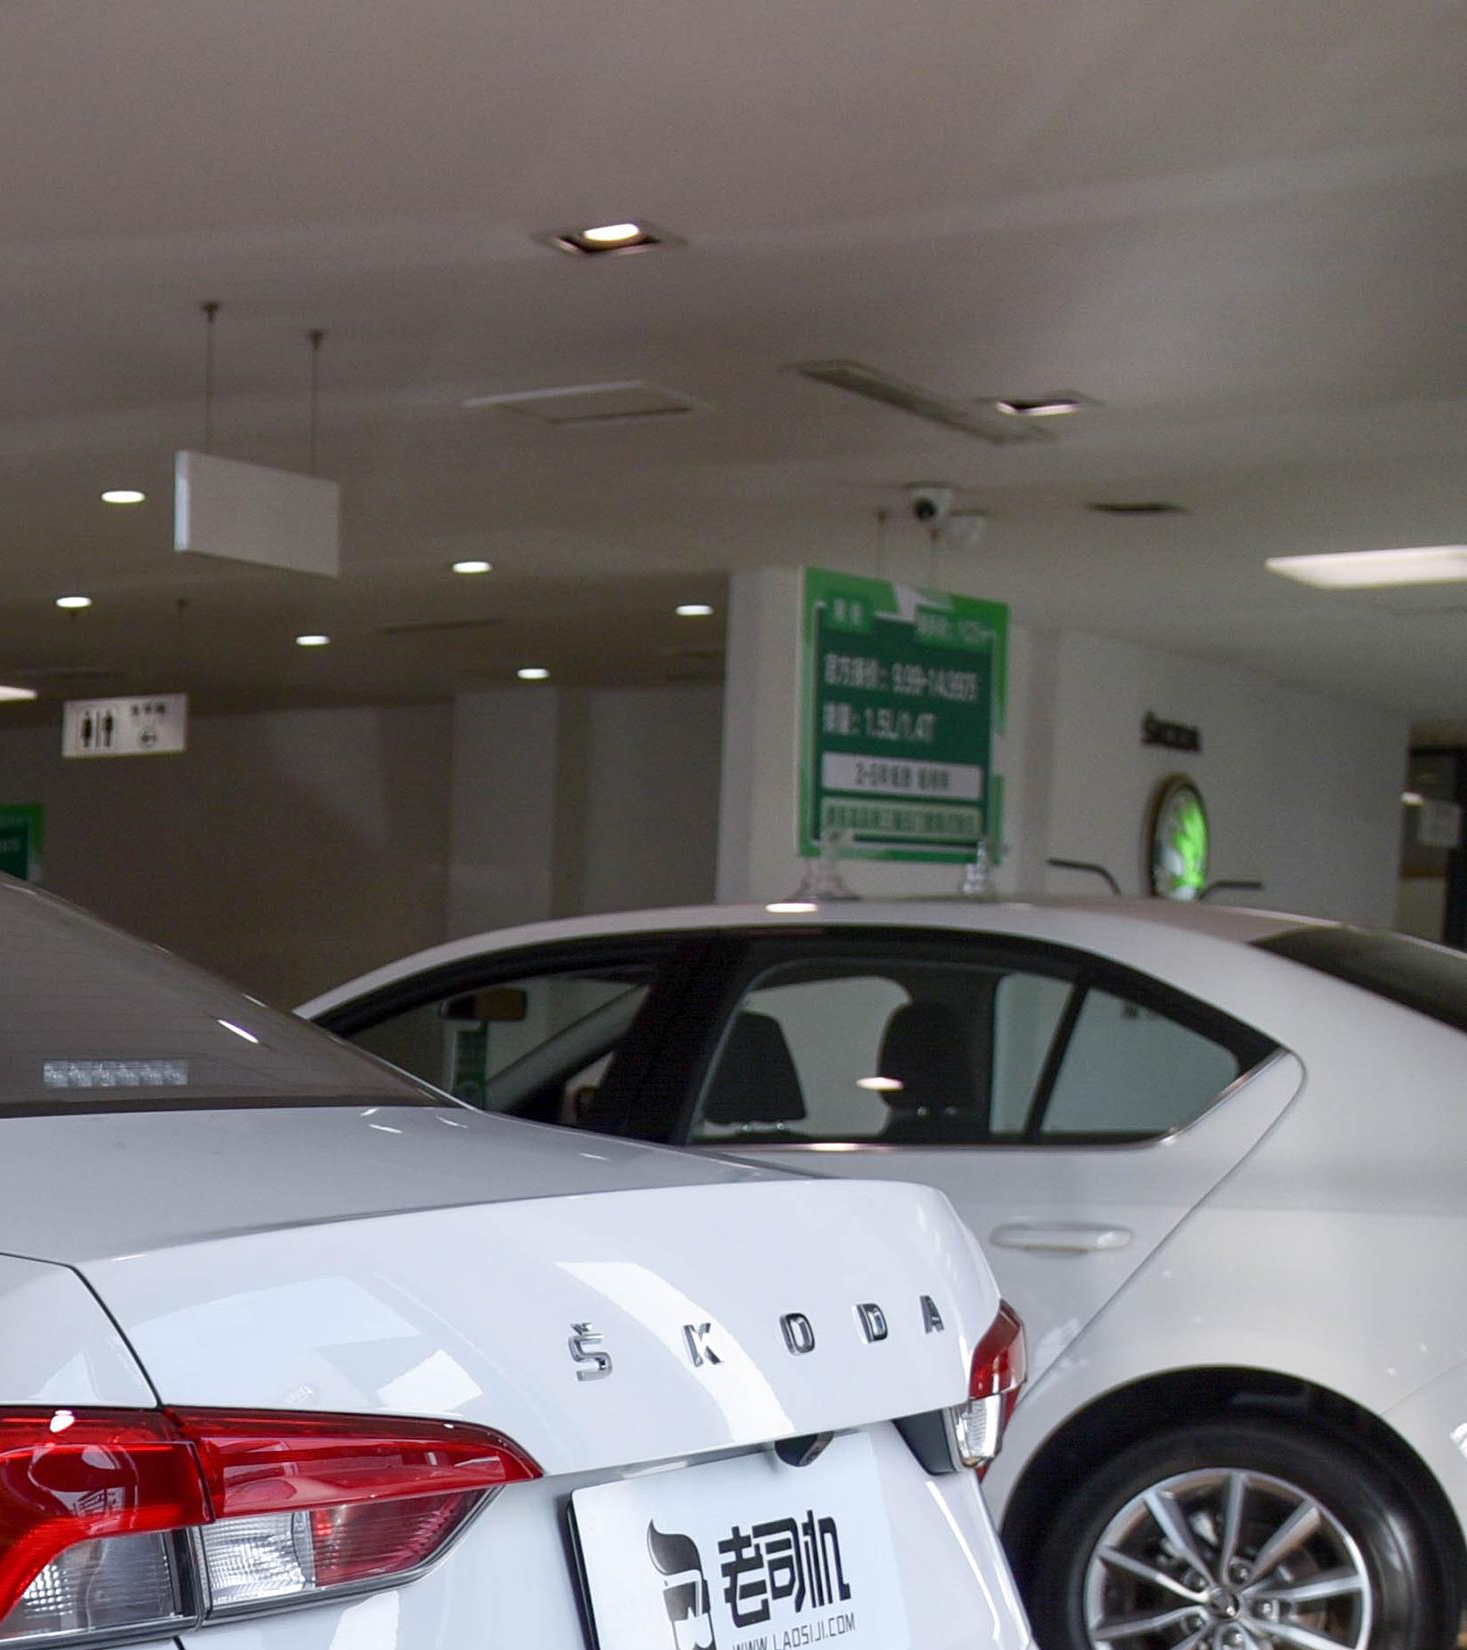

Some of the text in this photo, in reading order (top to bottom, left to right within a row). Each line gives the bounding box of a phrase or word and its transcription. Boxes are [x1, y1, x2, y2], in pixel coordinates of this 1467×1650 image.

[567, 1294, 945, 1383] ŠKODA
[717, 1509, 852, 1629] 老司机
